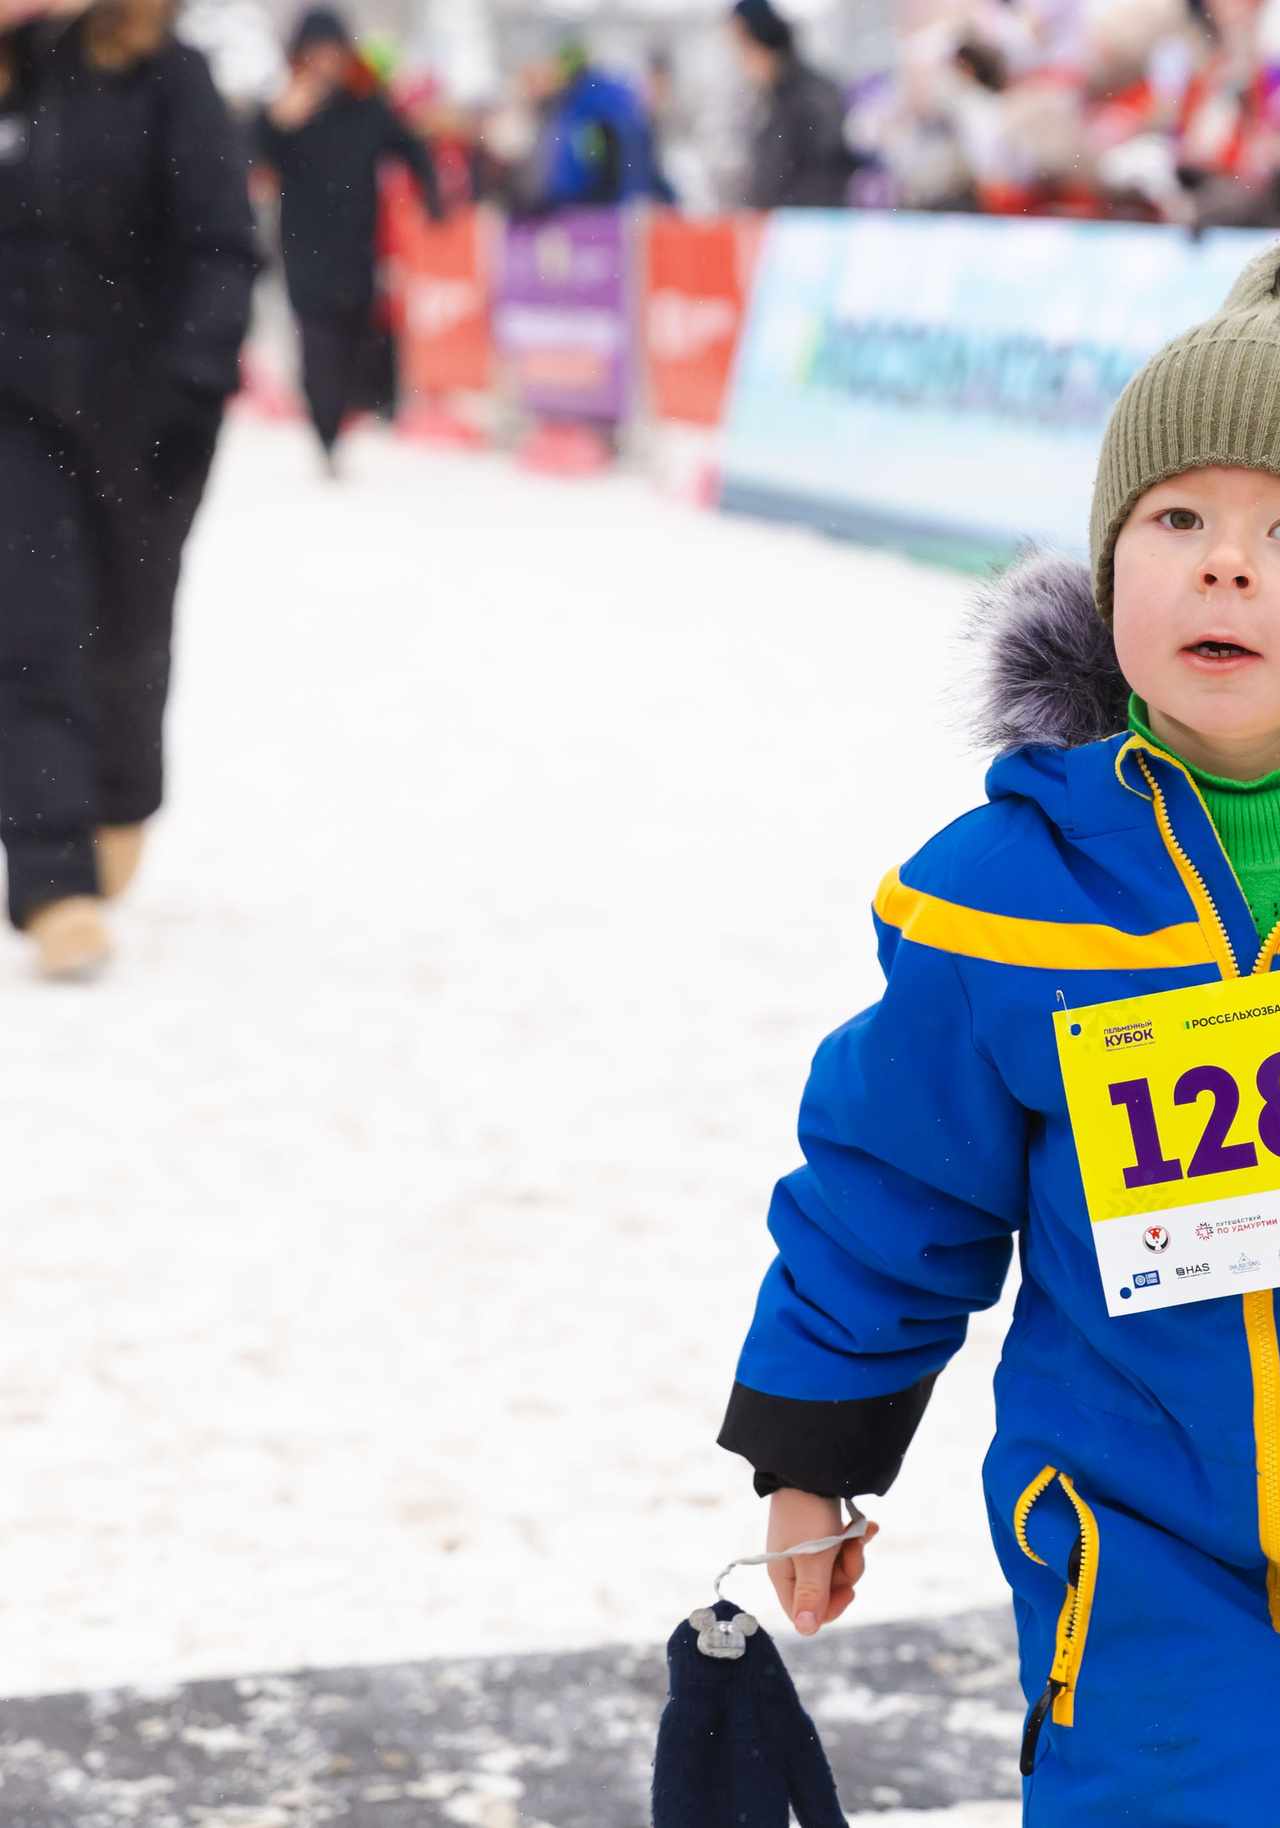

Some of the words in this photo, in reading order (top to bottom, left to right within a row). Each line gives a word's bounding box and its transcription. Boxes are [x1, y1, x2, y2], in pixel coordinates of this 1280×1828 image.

[1103, 1019, 1153, 1035] ПЕЛЬМЕННЫЙ
[1104, 1028, 1155, 1047] КУБОК
[1215, 1215, 1261, 1227] ПУТЕШЕСТВУЙ
[1216, 1226, 1230, 1235] ПО
[1231, 1219, 1278, 1233] УДМУРТИИ
[1185, 1262, 1210, 1275] HAS
